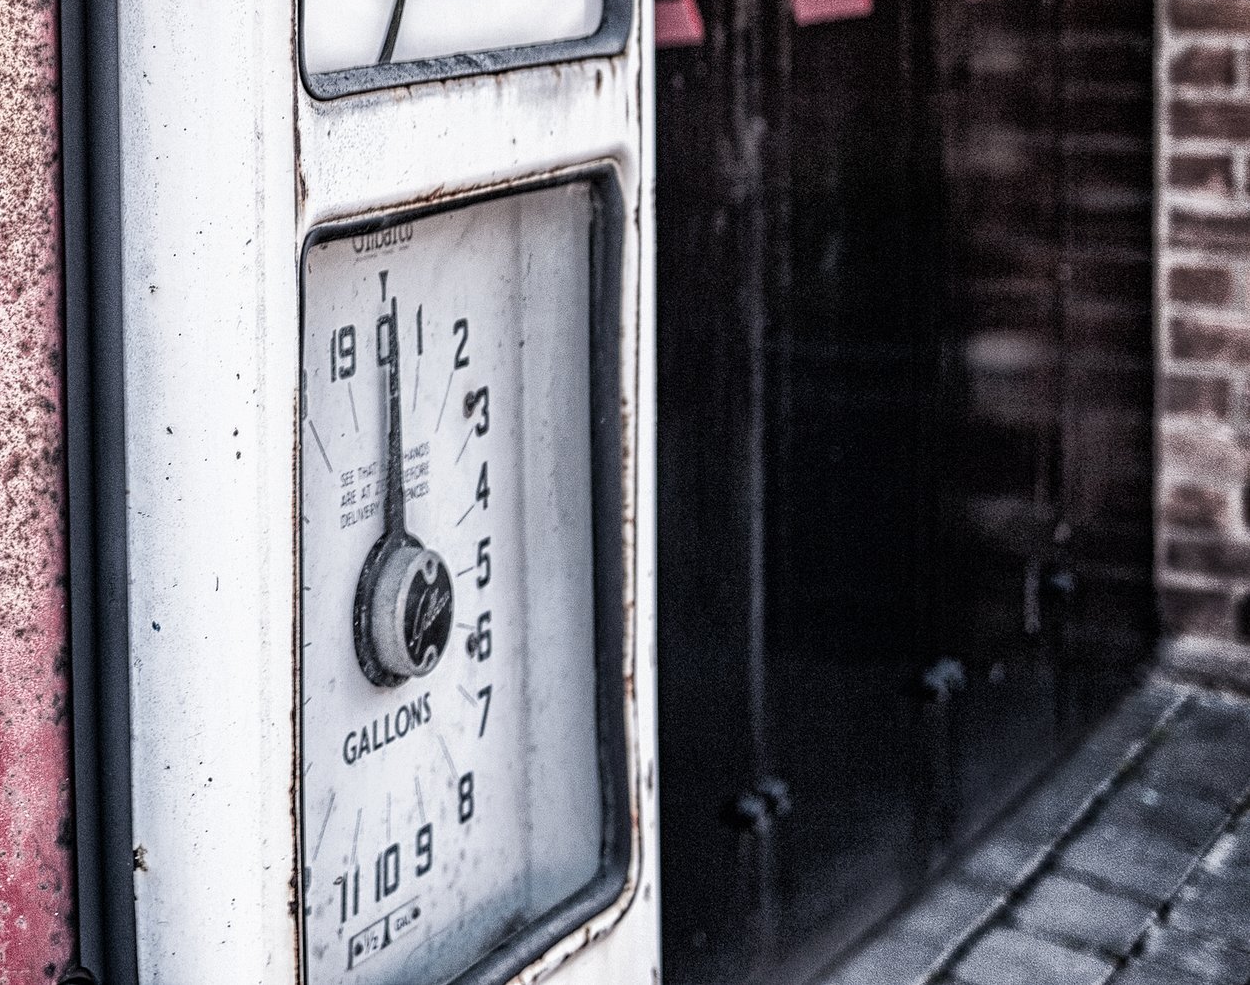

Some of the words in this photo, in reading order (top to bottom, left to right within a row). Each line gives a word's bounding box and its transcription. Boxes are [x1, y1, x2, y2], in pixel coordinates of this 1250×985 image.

[330, 324, 357, 383] 19
[453, 317, 470, 370] 2
[468, 385, 490, 438] 3
[475, 461, 491, 511] 4
[475, 537, 491, 590] 5
[475, 611, 492, 663] 6
[342, 692, 432, 766] GALLONS
[477, 684, 493, 739] 7
[457, 771, 475, 825] 8
[374, 843, 401, 903] 10
[415, 822, 434, 878] 9
[340, 864, 360, 924] 11
